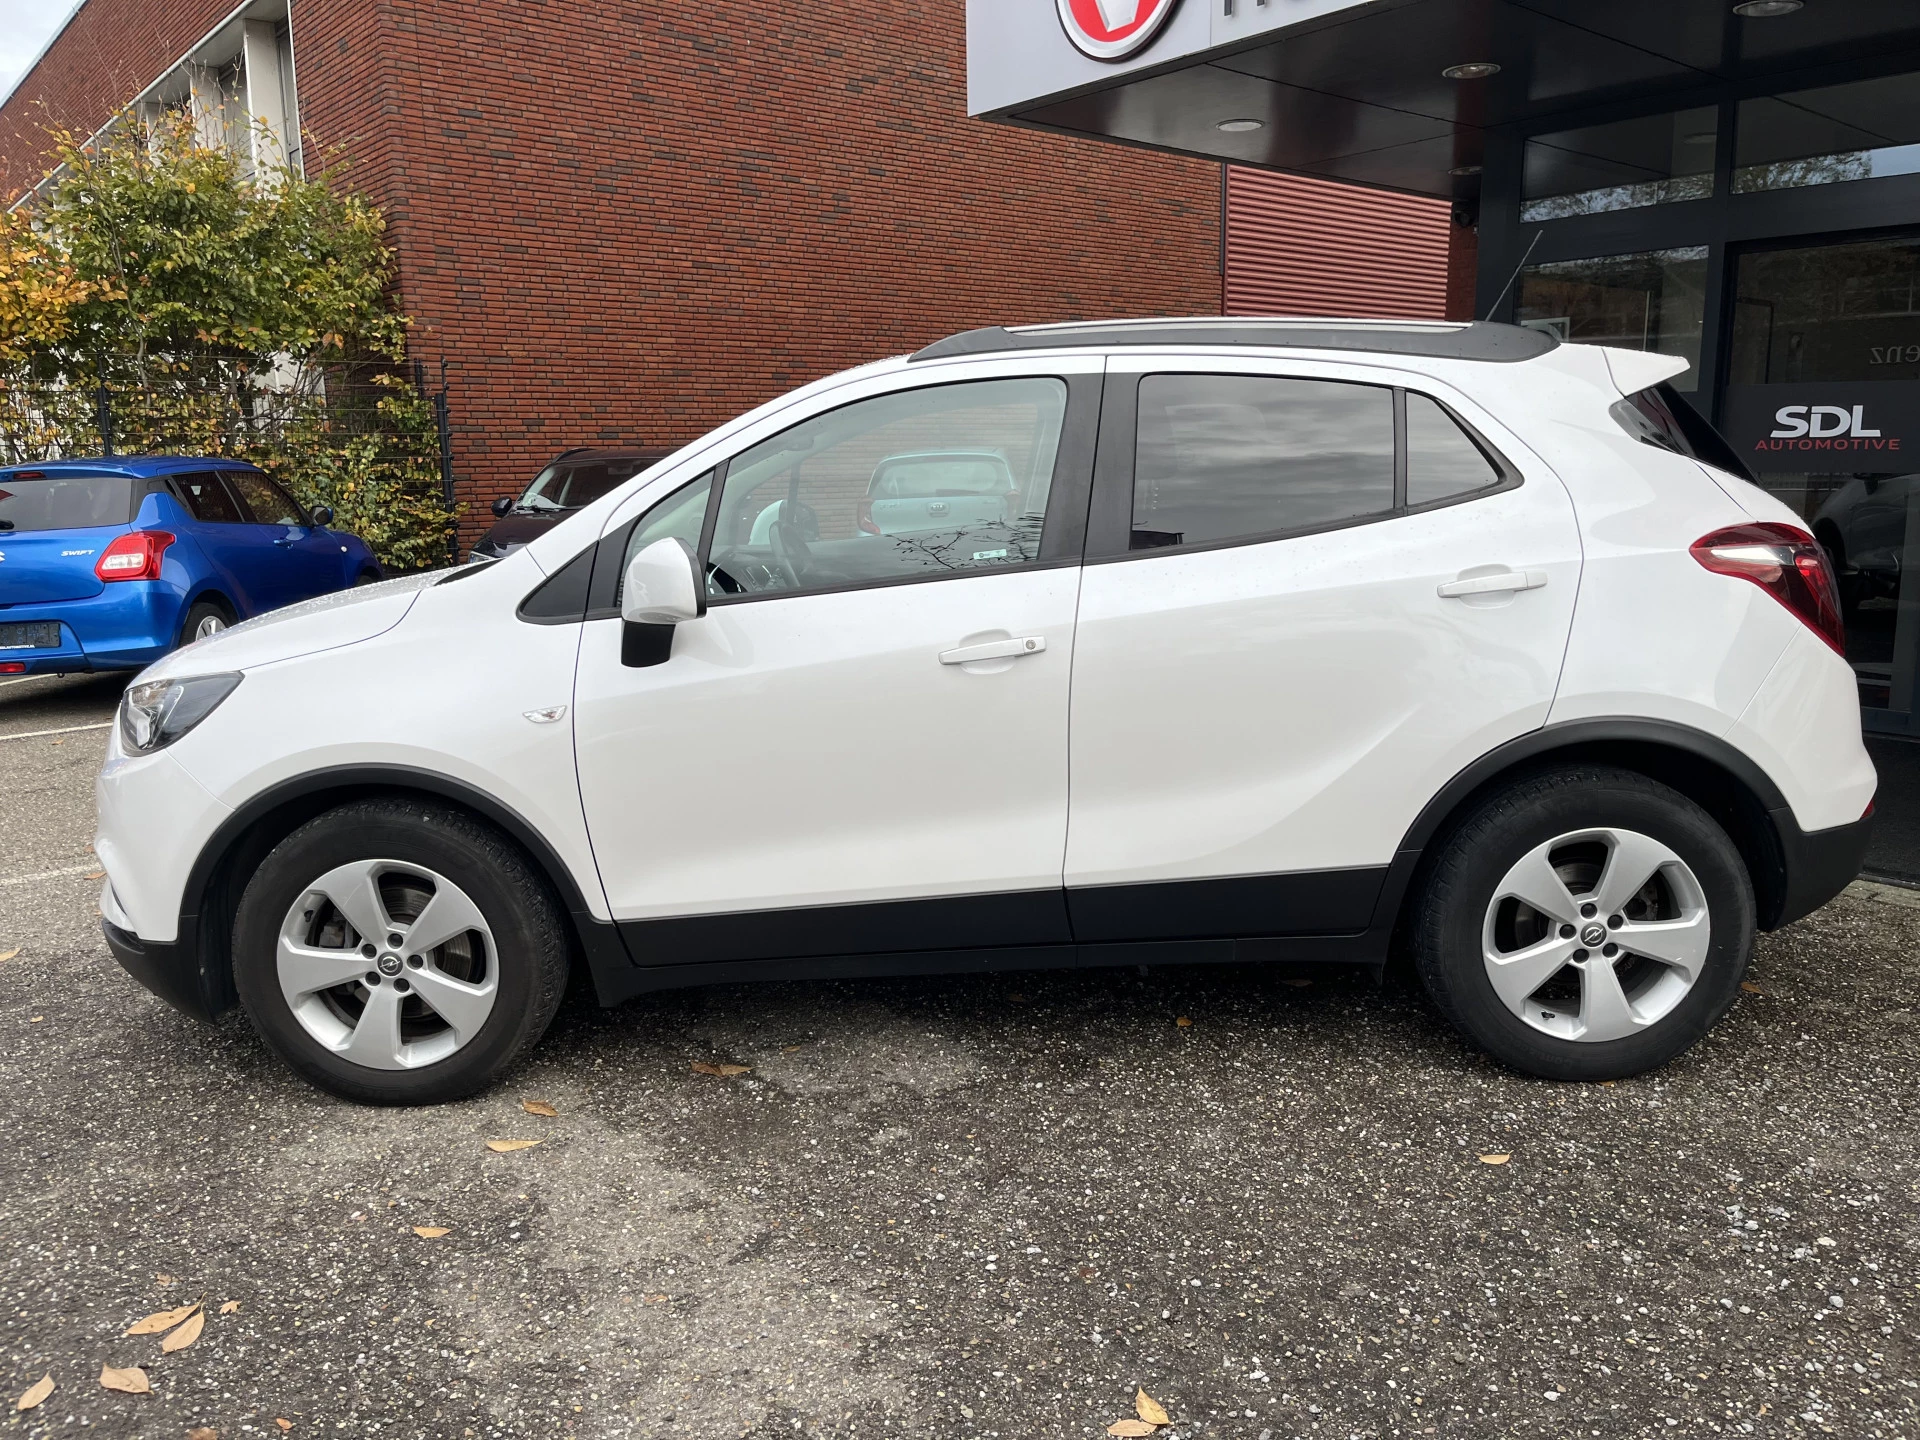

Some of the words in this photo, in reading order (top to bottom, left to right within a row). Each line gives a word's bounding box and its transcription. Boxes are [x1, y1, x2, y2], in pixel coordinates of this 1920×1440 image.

[1770, 404, 1881, 438] SDL
[1755, 438, 1900, 450] AUTOMOTIVE
[61, 549, 95, 557] SWIFT
